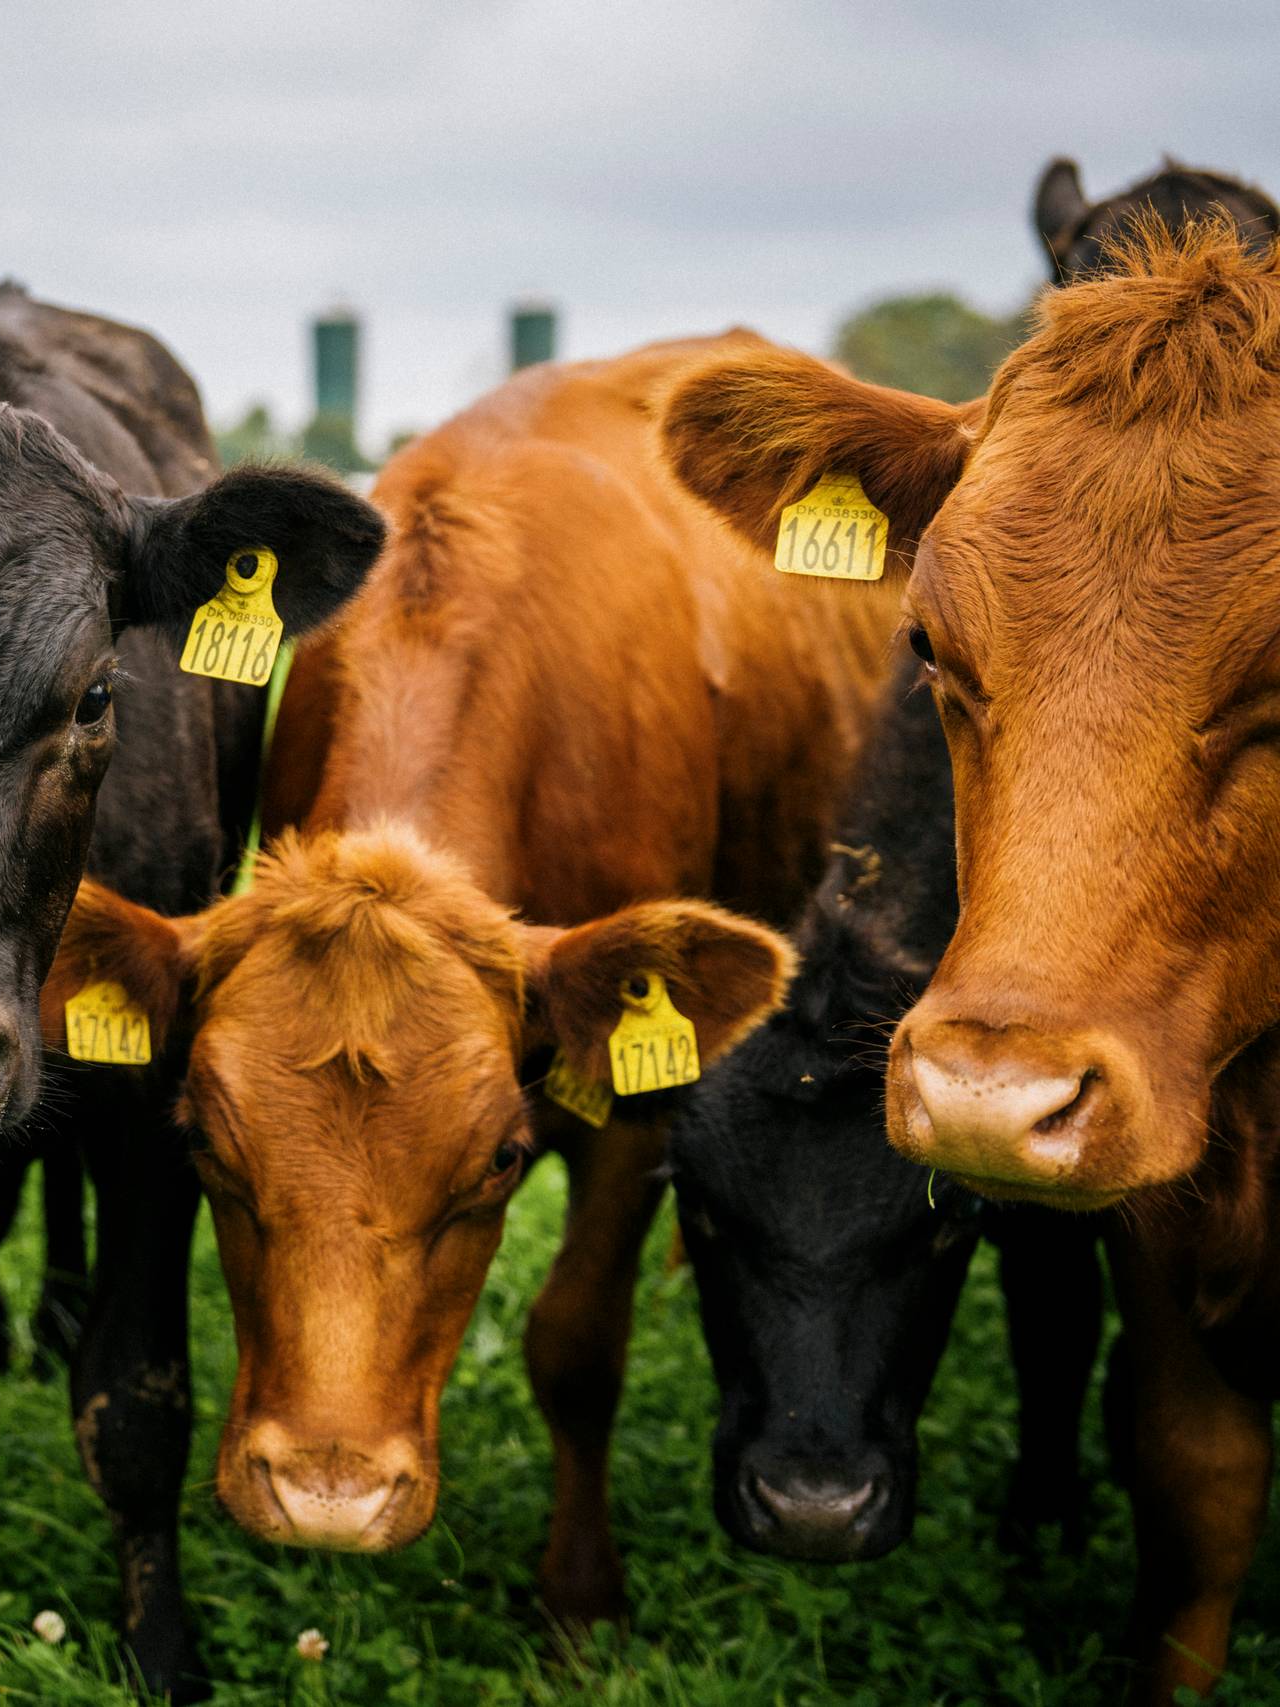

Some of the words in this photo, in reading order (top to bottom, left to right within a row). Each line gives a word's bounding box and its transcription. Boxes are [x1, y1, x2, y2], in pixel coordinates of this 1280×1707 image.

[796, 504, 817, 516] DK
[823, 507, 878, 520] 038330
[786, 516, 880, 575] 16611
[207, 606, 225, 619] DK
[229, 610, 273, 627] 038330
[190, 619, 274, 681] 18116
[619, 1035, 695, 1094] 17142
